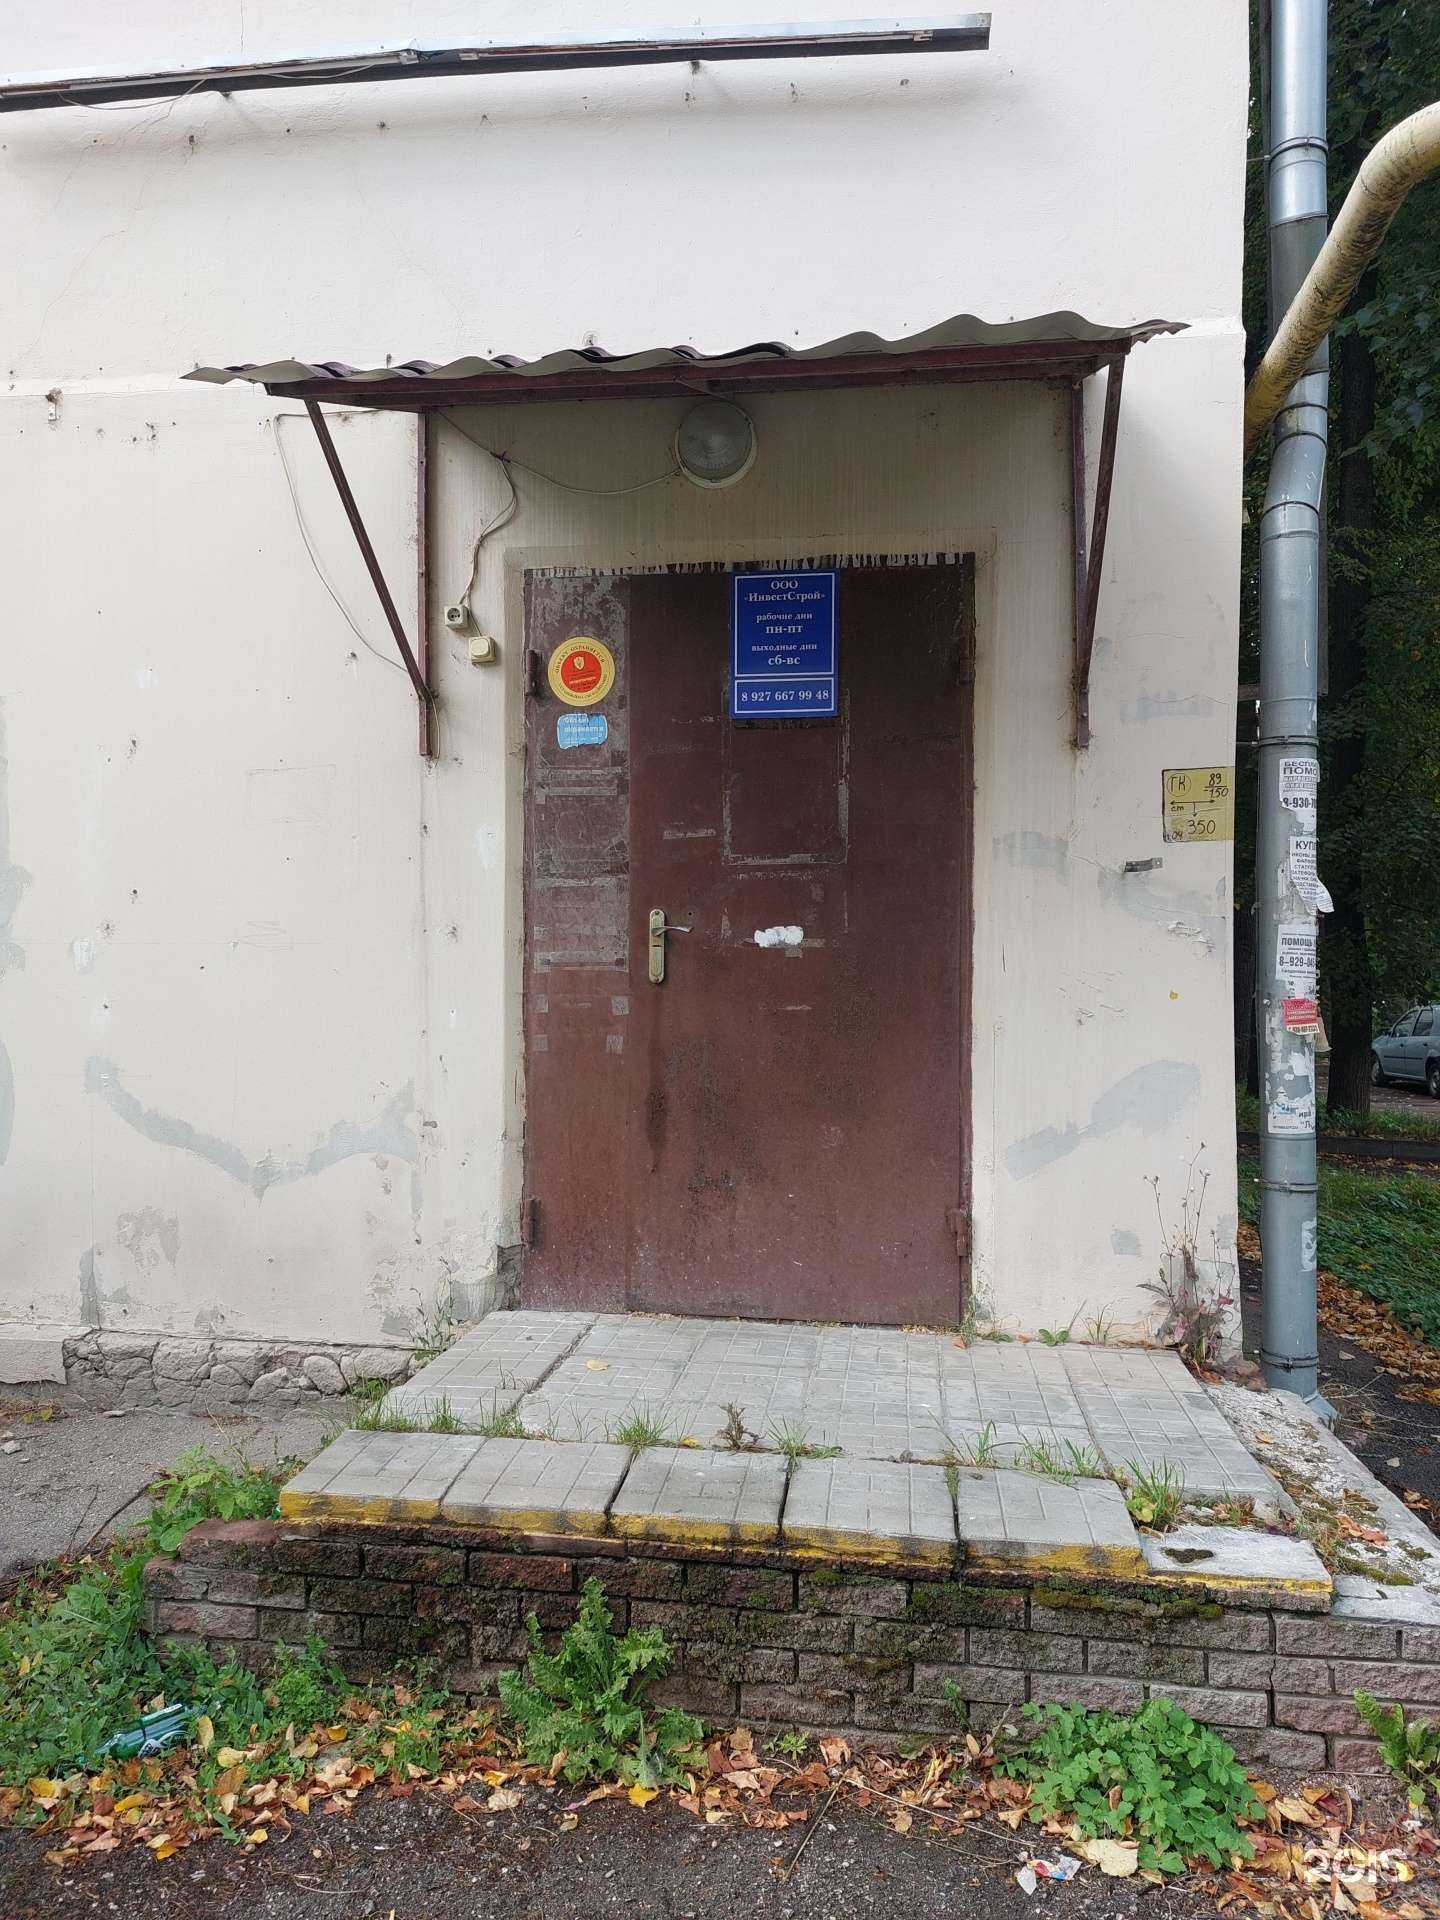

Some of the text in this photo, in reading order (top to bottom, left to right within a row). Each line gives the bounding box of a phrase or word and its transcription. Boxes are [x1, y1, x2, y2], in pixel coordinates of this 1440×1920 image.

[771, 580, 799, 590] ООО
[756, 612, 813, 623] рабочие дни
[751, 643, 818, 652] выходные дни
[741, 689, 830, 702] 8 927 667 99 48
[1208, 773, 1222, 785] 89
[1187, 819, 1216, 835] 350
[1281, 937, 1313, 947] ПОМОЩЬ
